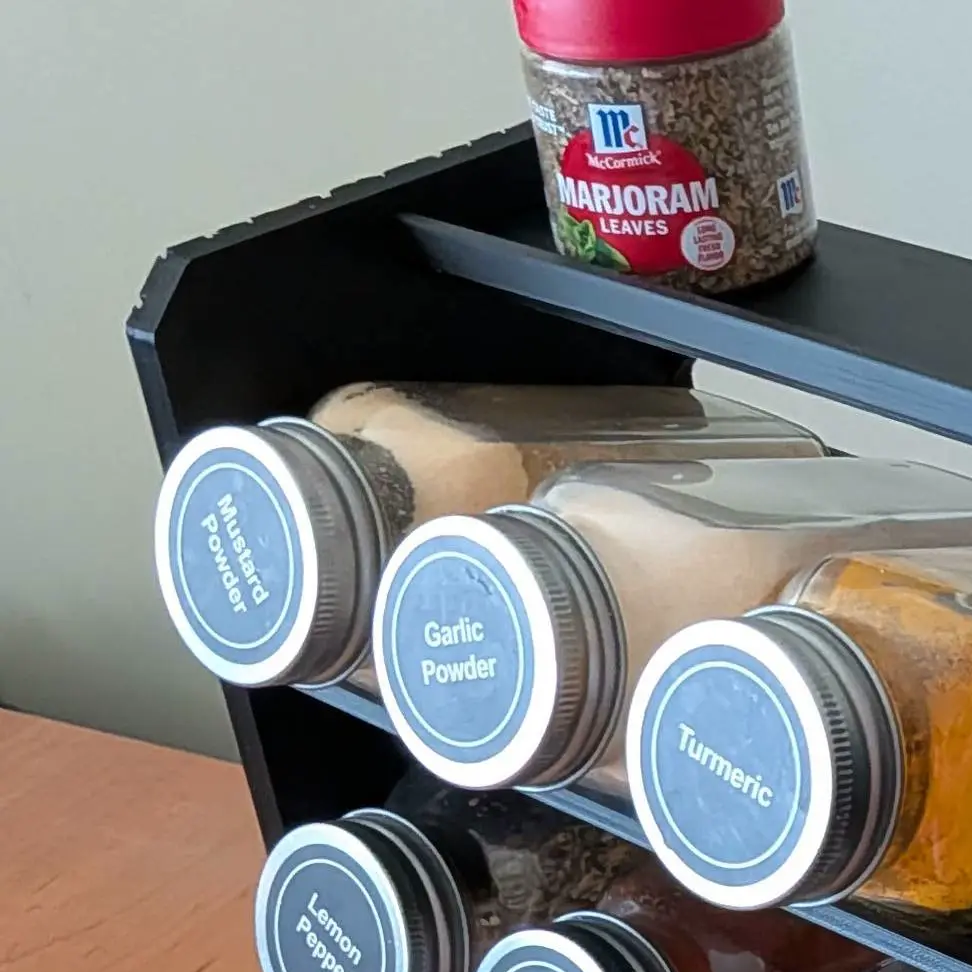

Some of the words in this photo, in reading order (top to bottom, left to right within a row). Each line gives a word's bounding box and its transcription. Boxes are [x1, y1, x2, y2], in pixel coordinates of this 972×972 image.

[556, 173, 719, 217] MARJORAM
[600, 217, 669, 236] LEAVES
[201, 513, 247, 613] Powder
[217, 493, 270, 605] Mustard
[424, 616, 485, 648] Garlic
[421, 653, 497, 686] Powder
[678, 722, 773, 808] Turmeric
[307, 892, 362, 966] Lemon
